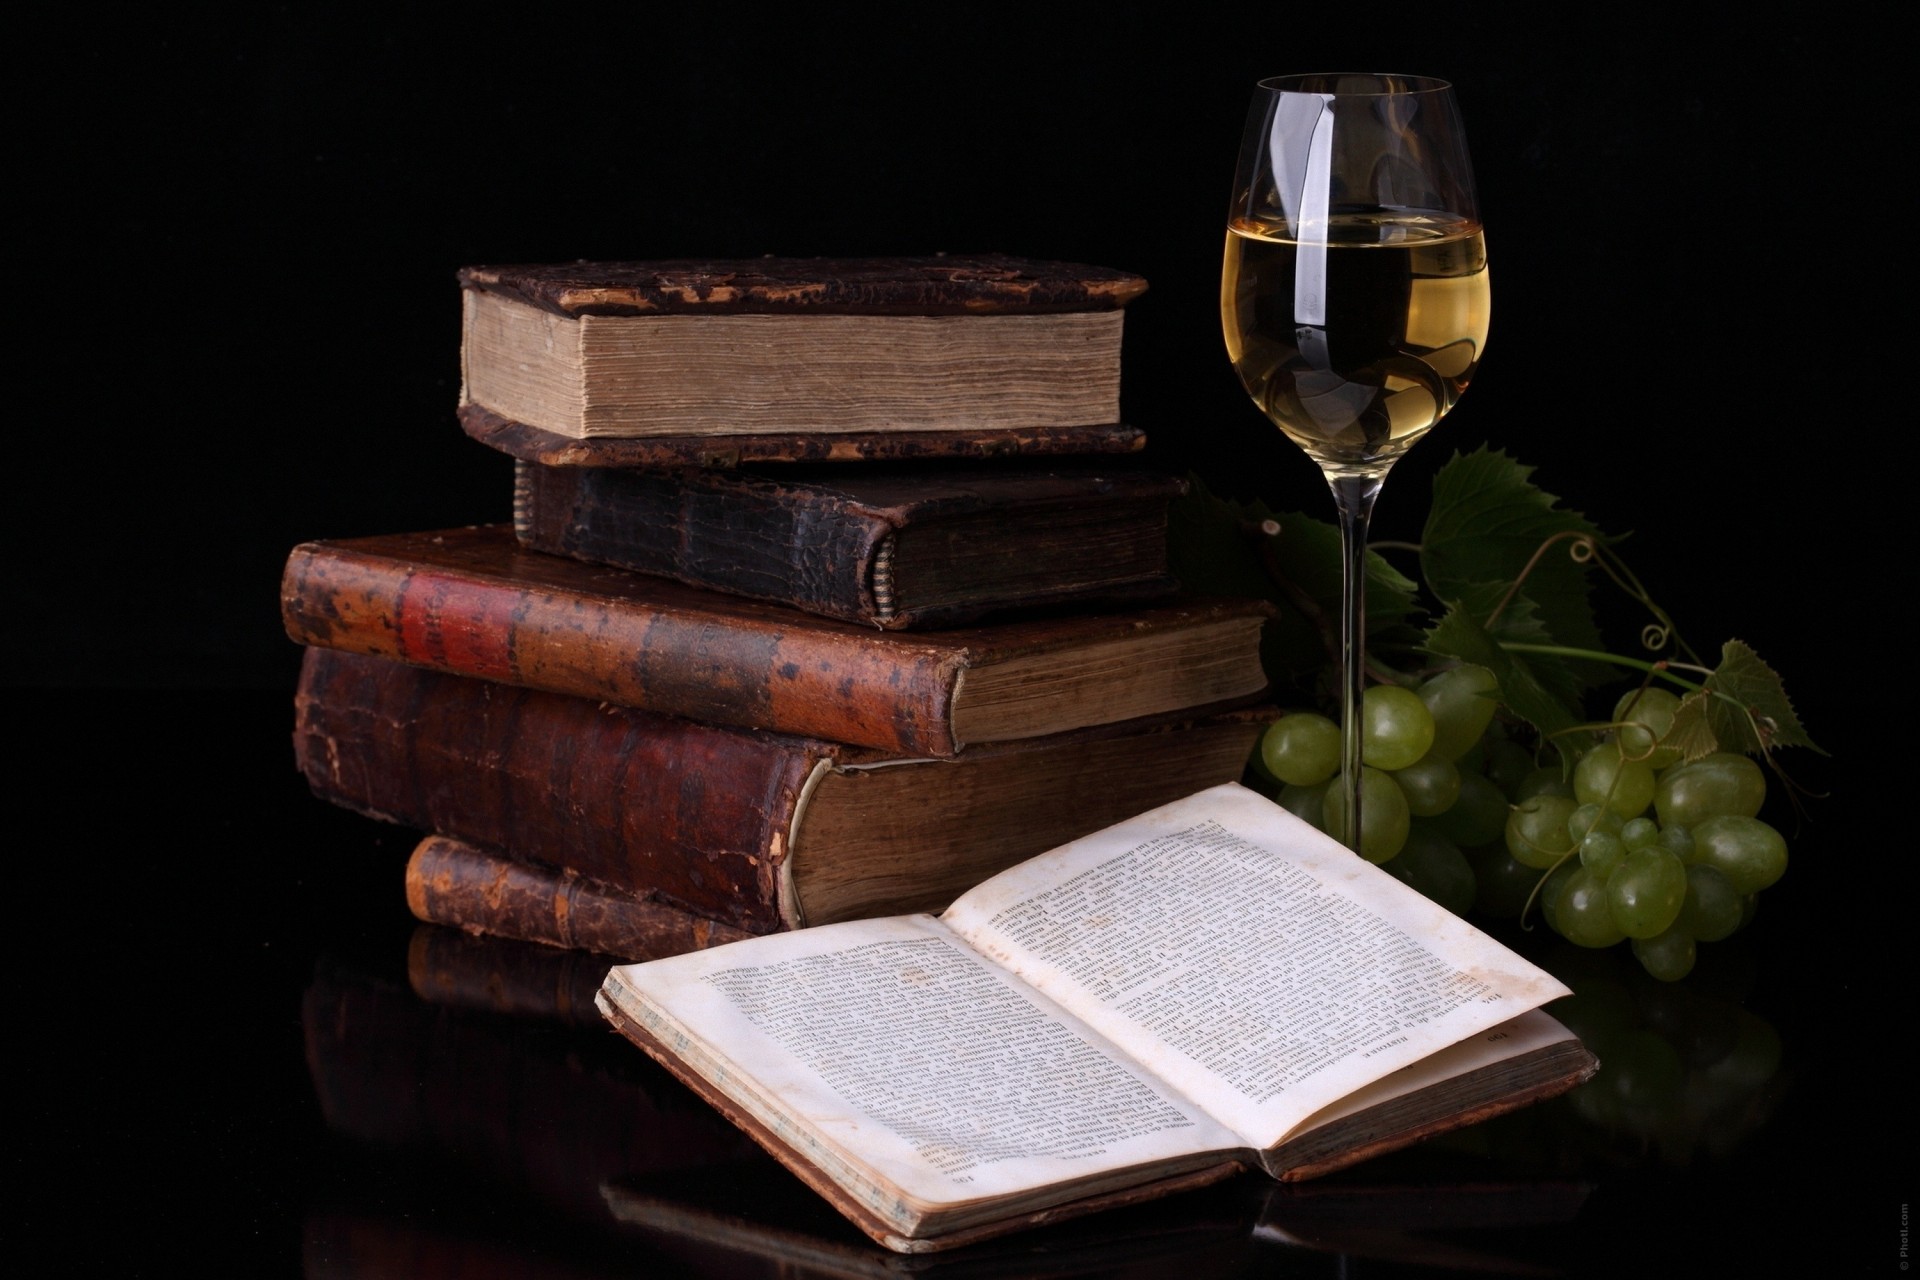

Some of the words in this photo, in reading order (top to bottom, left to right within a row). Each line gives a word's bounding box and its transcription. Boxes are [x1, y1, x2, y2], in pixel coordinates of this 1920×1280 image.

[1135, 843, 1149, 851] lui
[1096, 850, 1134, 869] demanda
[1158, 851, 1198, 872] Quelques
[1257, 857, 1281, 870] nison
[1063, 869, 1094, 887] ensuite
[1120, 874, 1156, 891] Thraces
[1196, 870, 1255, 899] macédonienne
[1277, 877, 1316, 900] puissants
[1310, 882, 1323, 893] sur
[1036, 891, 1052, 900] elle
[1092, 892, 1116, 905] ayant
[1004, 898, 1034, 914] n'avait
[1061, 904, 1089, 919] abattu
[1169, 899, 1193, 912] ayant
[1267, 906, 1282, 914] fut
[1278, 894, 1320, 916] Alexandre
[987, 913, 1002, 925] pas
[1217, 910, 1251, 929] prendre
[1238, 914, 1264, 928] obligé
[1247, 916, 1276, 930] voyant
[1013, 927, 1044, 942] maison
[1090, 931, 1127, 949] citadelle
[1229, 930, 1245, 940] que
[1344, 921, 1388, 945] demandait
[1166, 952, 1182, 960] des
[1182, 945, 1216, 963] douceur
[1298, 944, 1343, 967] seulement
[1379, 945, 1406, 958] même
[1132, 957, 1154, 968] livra
[916, 970, 949, 980] prêtres
[1112, 968, 1129, 978] aux
[1116, 962, 1162, 984] arguments
[1150, 962, 1179, 978] n'avait
[1121, 978, 1148, 992] aucun
[1328, 965, 1378, 991] convainquit
[836, 992, 880, 1001] habitants
[1093, 984, 1113, 996] plus
[1100, 991, 1120, 1002] effet
[1302, 987, 1318, 996] son
[1460, 985, 1491, 1003] grande
[1268, 996, 1300, 1013] arrivée
[1283, 999, 1310, 1012] Grecs
[1481, 993, 1503, 1004] 194
[1432, 1003, 1459, 1018] partie
[996, 1019, 1042, 1030] Alexandre
[912, 1036, 950, 1047] pendant
[1013, 1037, 1049, 1046] réponse
[1195, 1028, 1235, 1048] soudaine
[1361, 1026, 1400, 1046] garnison
[871, 1044, 908, 1054] quelque
[958, 1044, 1011, 1057] magnanime
[1190, 1046, 1213, 1060] mort
[1362, 1036, 1408, 1058] HISTOIRE
[826, 1075, 849, 1084] avait
[1062, 1078, 1121, 1093] conduisirent
[1025, 1091, 1057, 1100] devant
[1256, 1086, 1284, 1104] placée
[914, 1106, 948, 1117] femme
